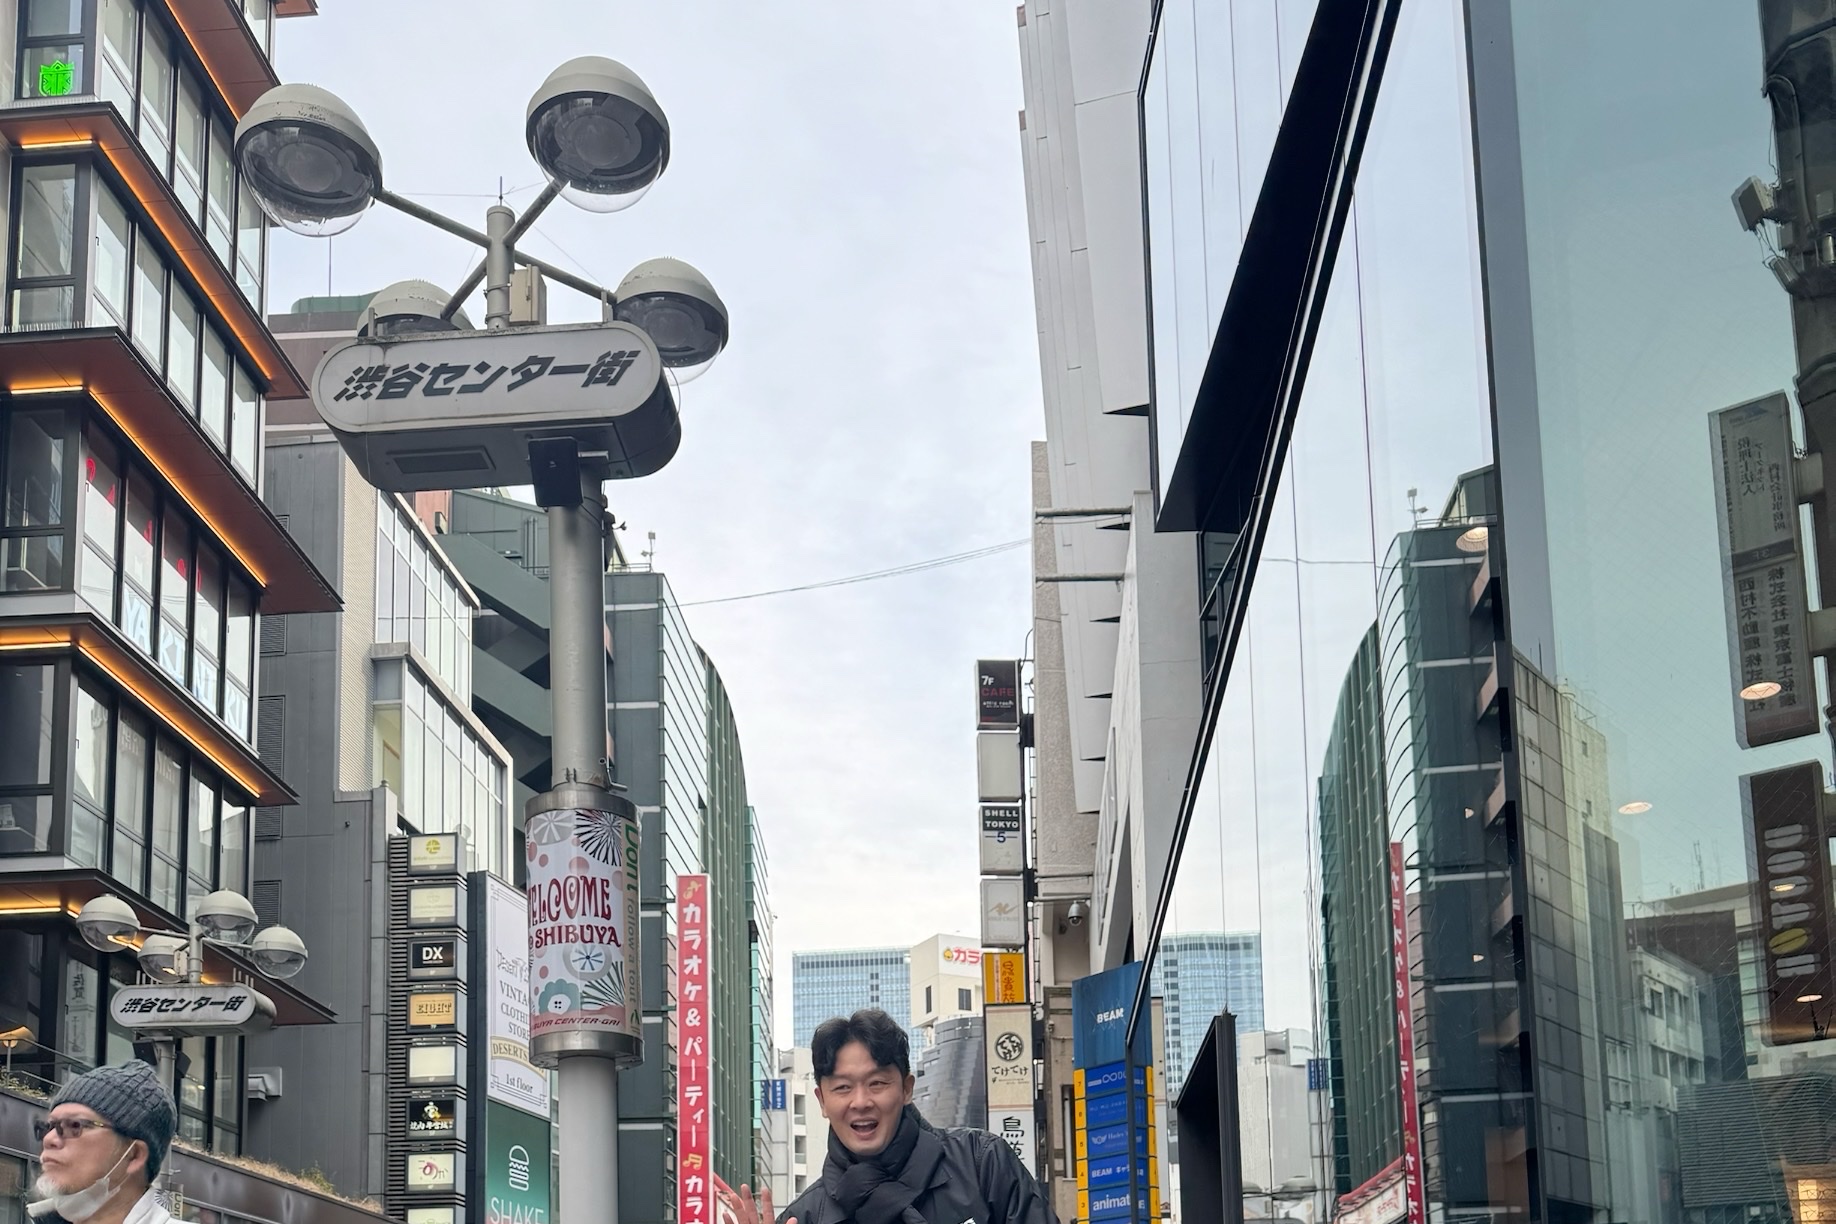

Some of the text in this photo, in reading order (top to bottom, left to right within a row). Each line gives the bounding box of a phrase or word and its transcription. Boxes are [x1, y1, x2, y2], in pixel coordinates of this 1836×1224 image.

[333, 348, 641, 402] 渋谷センター街
[981, 675, 995, 685] 7F
[981, 687, 1015, 697] CAFE
[984, 809, 1018, 817] SHELL
[985, 819, 1019, 829] TOKYO
[997, 831, 1006, 843] 5
[535, 923, 621, 950] SHIBUYA
[422, 946, 443, 960] DX
[953, 947, 980, 964] カラ
[499, 980, 529, 1007] VINTA
[119, 995, 248, 1015] 渋谷センター街
[501, 1002, 529, 1025] CLOTHI
[1096, 1007, 1125, 1024] BEAM
[1091, 1167, 1113, 1178] BEAM
[1092, 1194, 1131, 1212] animat
